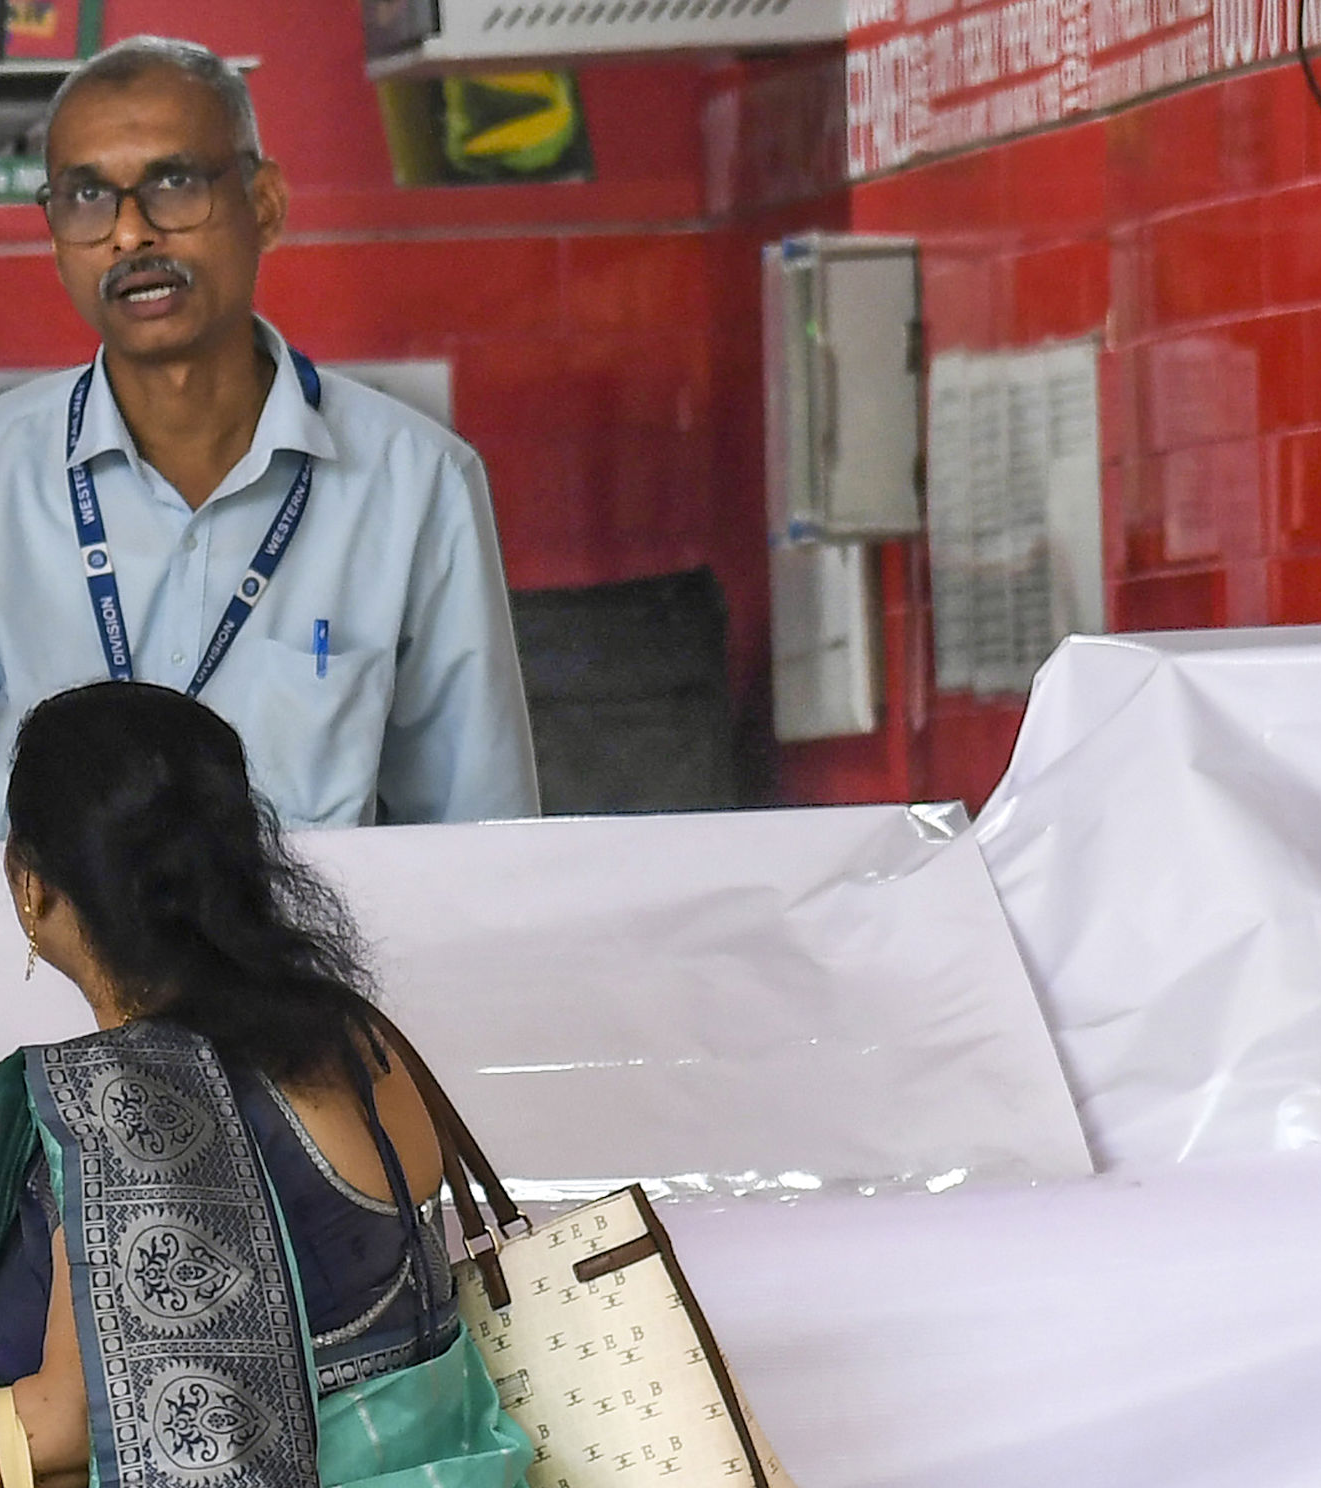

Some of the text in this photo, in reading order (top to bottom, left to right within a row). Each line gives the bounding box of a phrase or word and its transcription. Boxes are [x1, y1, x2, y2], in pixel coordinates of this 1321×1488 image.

[264, 488, 307, 557] WESTERN
[99, 595, 127, 666] DIVISION
[194, 619, 236, 684] DIVISION
